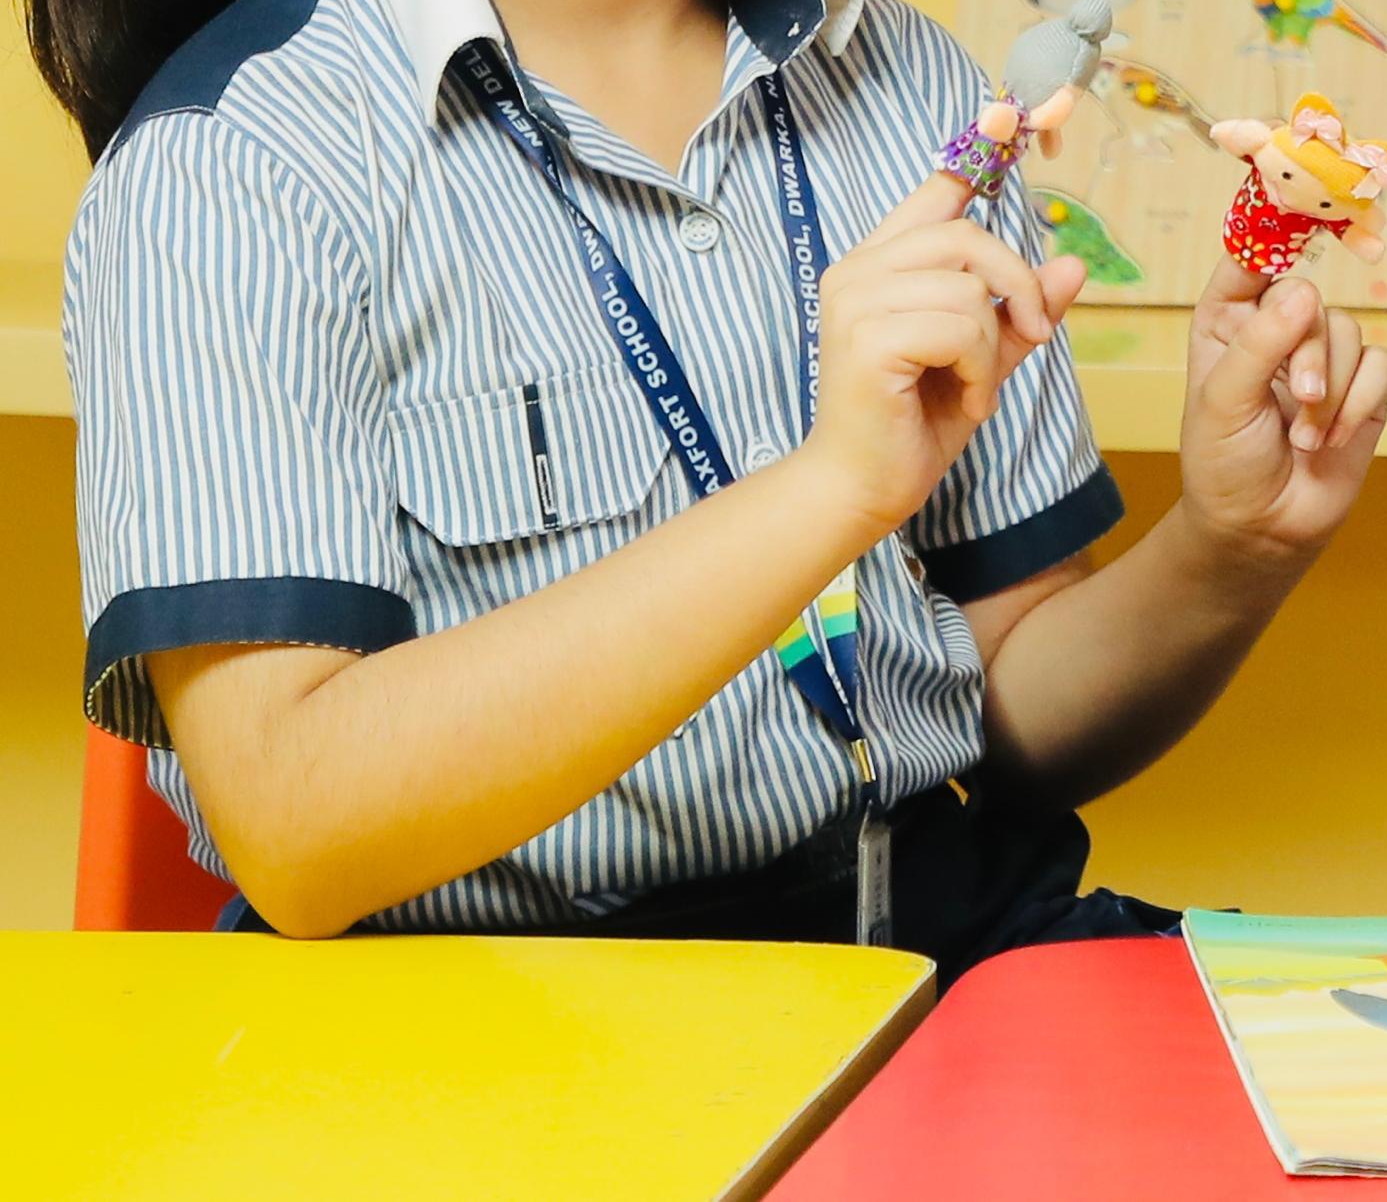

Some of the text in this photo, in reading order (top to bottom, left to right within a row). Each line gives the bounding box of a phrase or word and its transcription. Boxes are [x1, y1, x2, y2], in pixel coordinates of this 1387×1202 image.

[458, 43, 503, 95] DEL
[496, 100, 544, 147] NEW
[774, 107, 805, 217] DWARKA,
[602, 272, 668, 389] SCHOOL,
[658, 395, 720, 496] AXFORT
